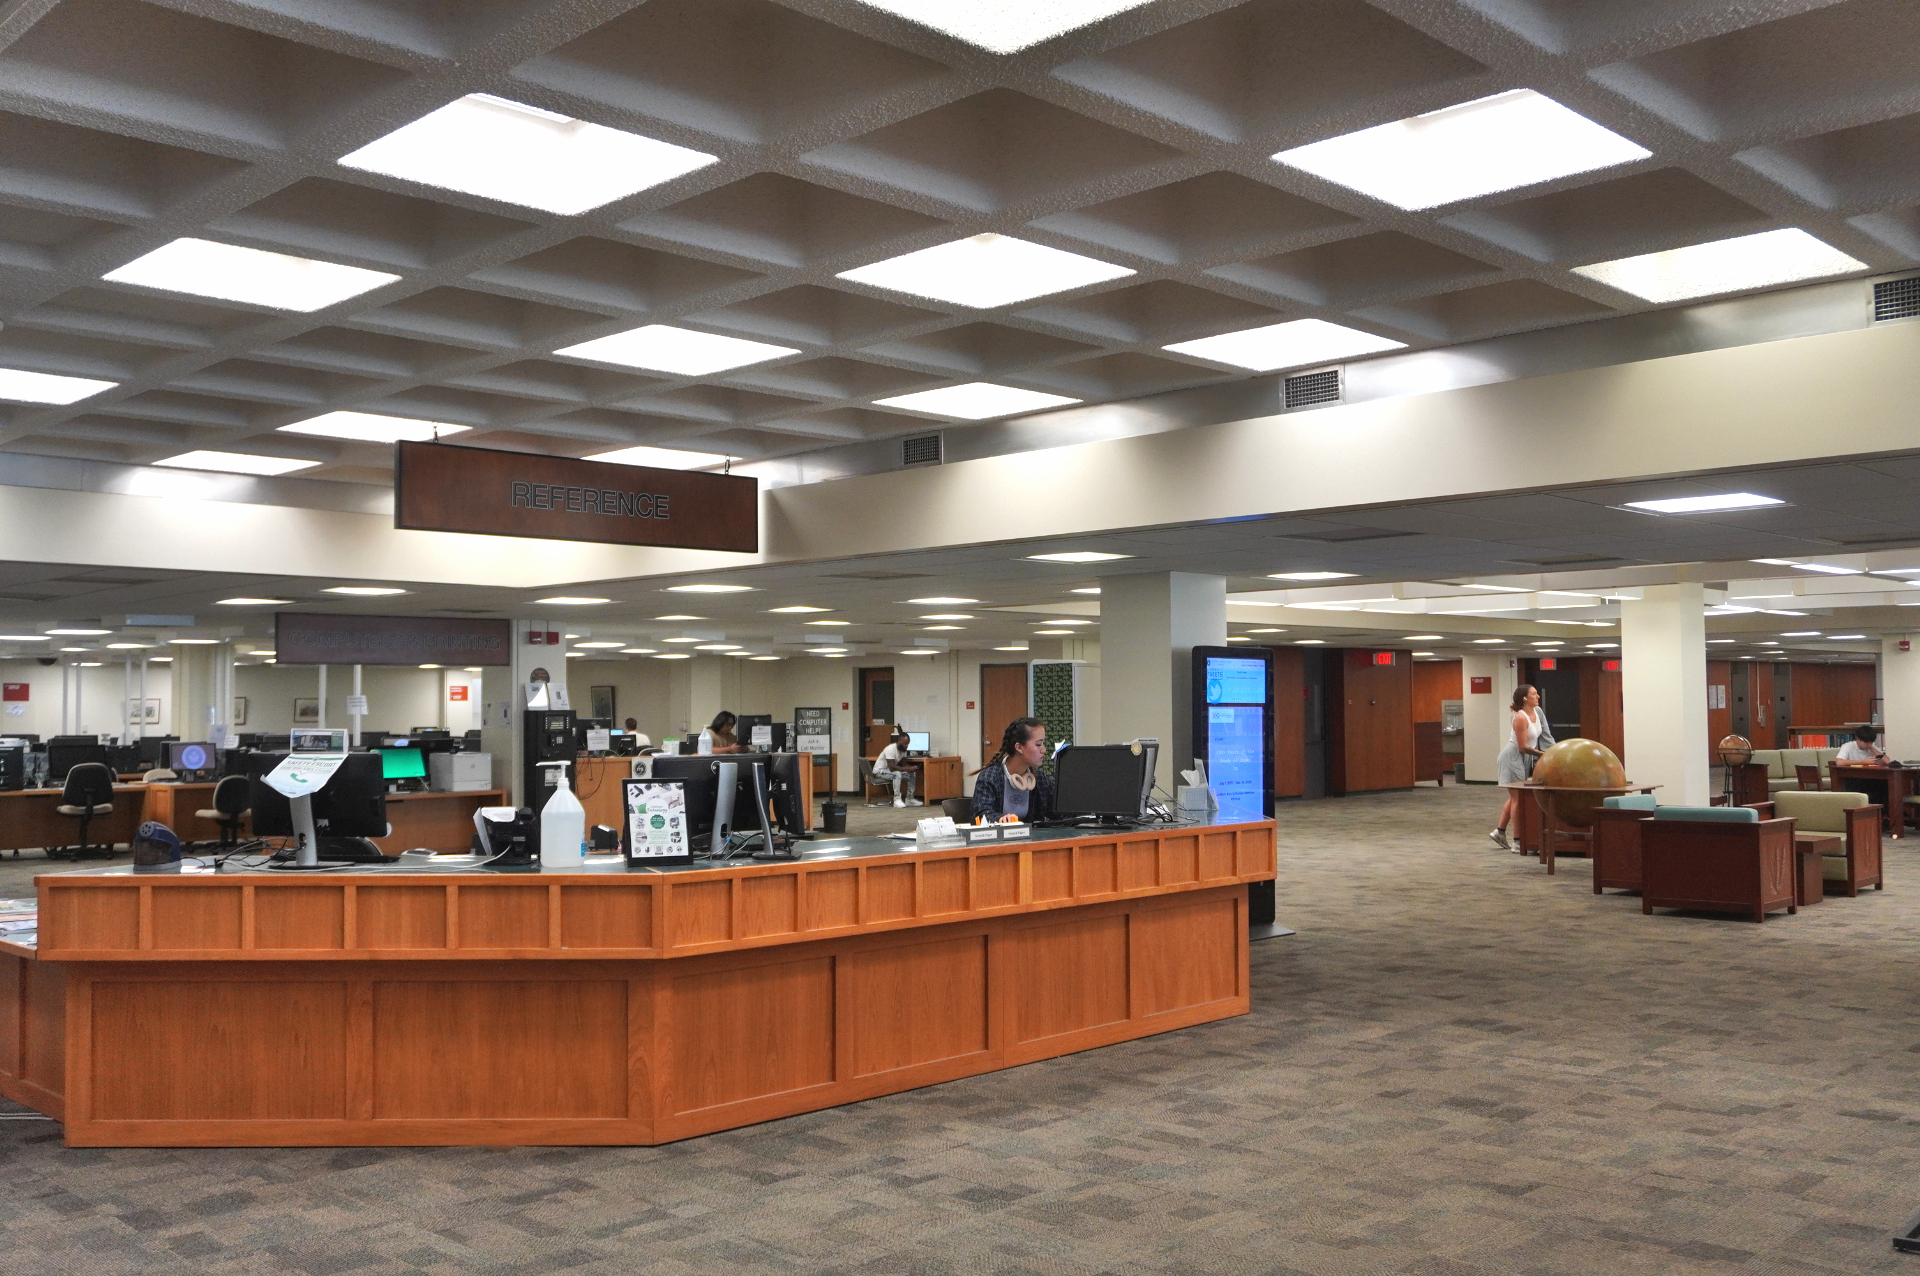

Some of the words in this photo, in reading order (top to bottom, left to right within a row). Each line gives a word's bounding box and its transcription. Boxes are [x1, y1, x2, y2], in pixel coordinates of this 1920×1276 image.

[511, 481, 670, 519] REFERENCE
[288, 629, 403, 651] COMPUTERS
[408, 634, 421, 651] &
[423, 634, 501, 652] PRINTING
[1378, 653, 1392, 664] EXIT
[1542, 660, 1554, 669] EXIT
[1606, 661, 1619, 670] EXIT
